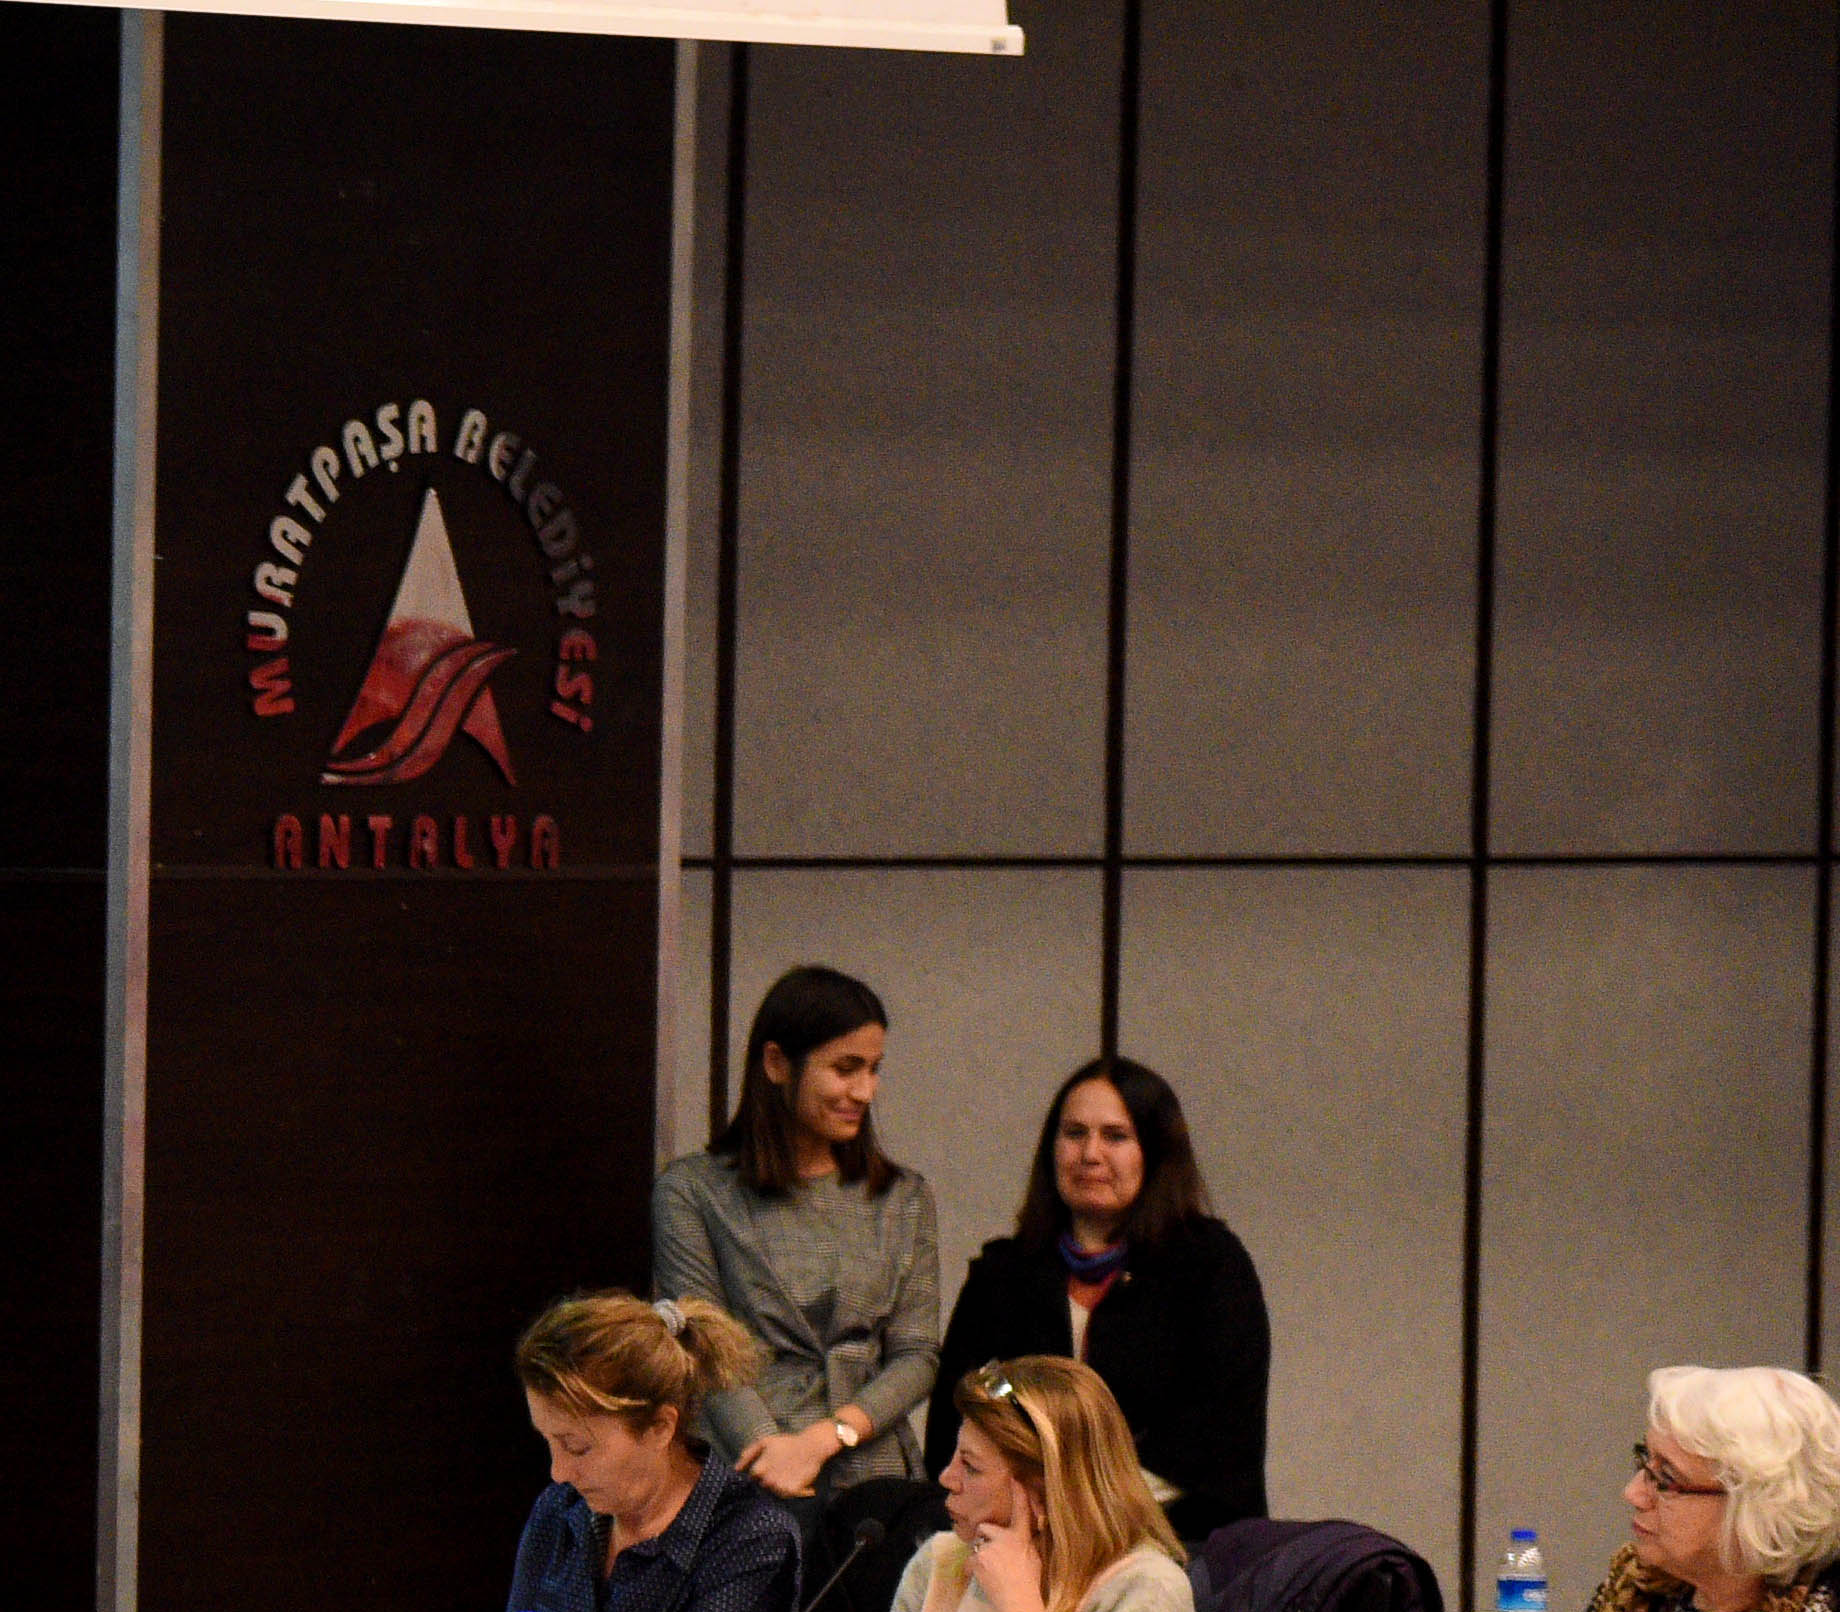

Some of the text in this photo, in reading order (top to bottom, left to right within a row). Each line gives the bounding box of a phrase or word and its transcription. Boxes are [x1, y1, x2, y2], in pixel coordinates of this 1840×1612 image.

[246, 398, 598, 732] MURATPAŞA BELEDİYESİ
[273, 812, 560, 870] ANTALYA
